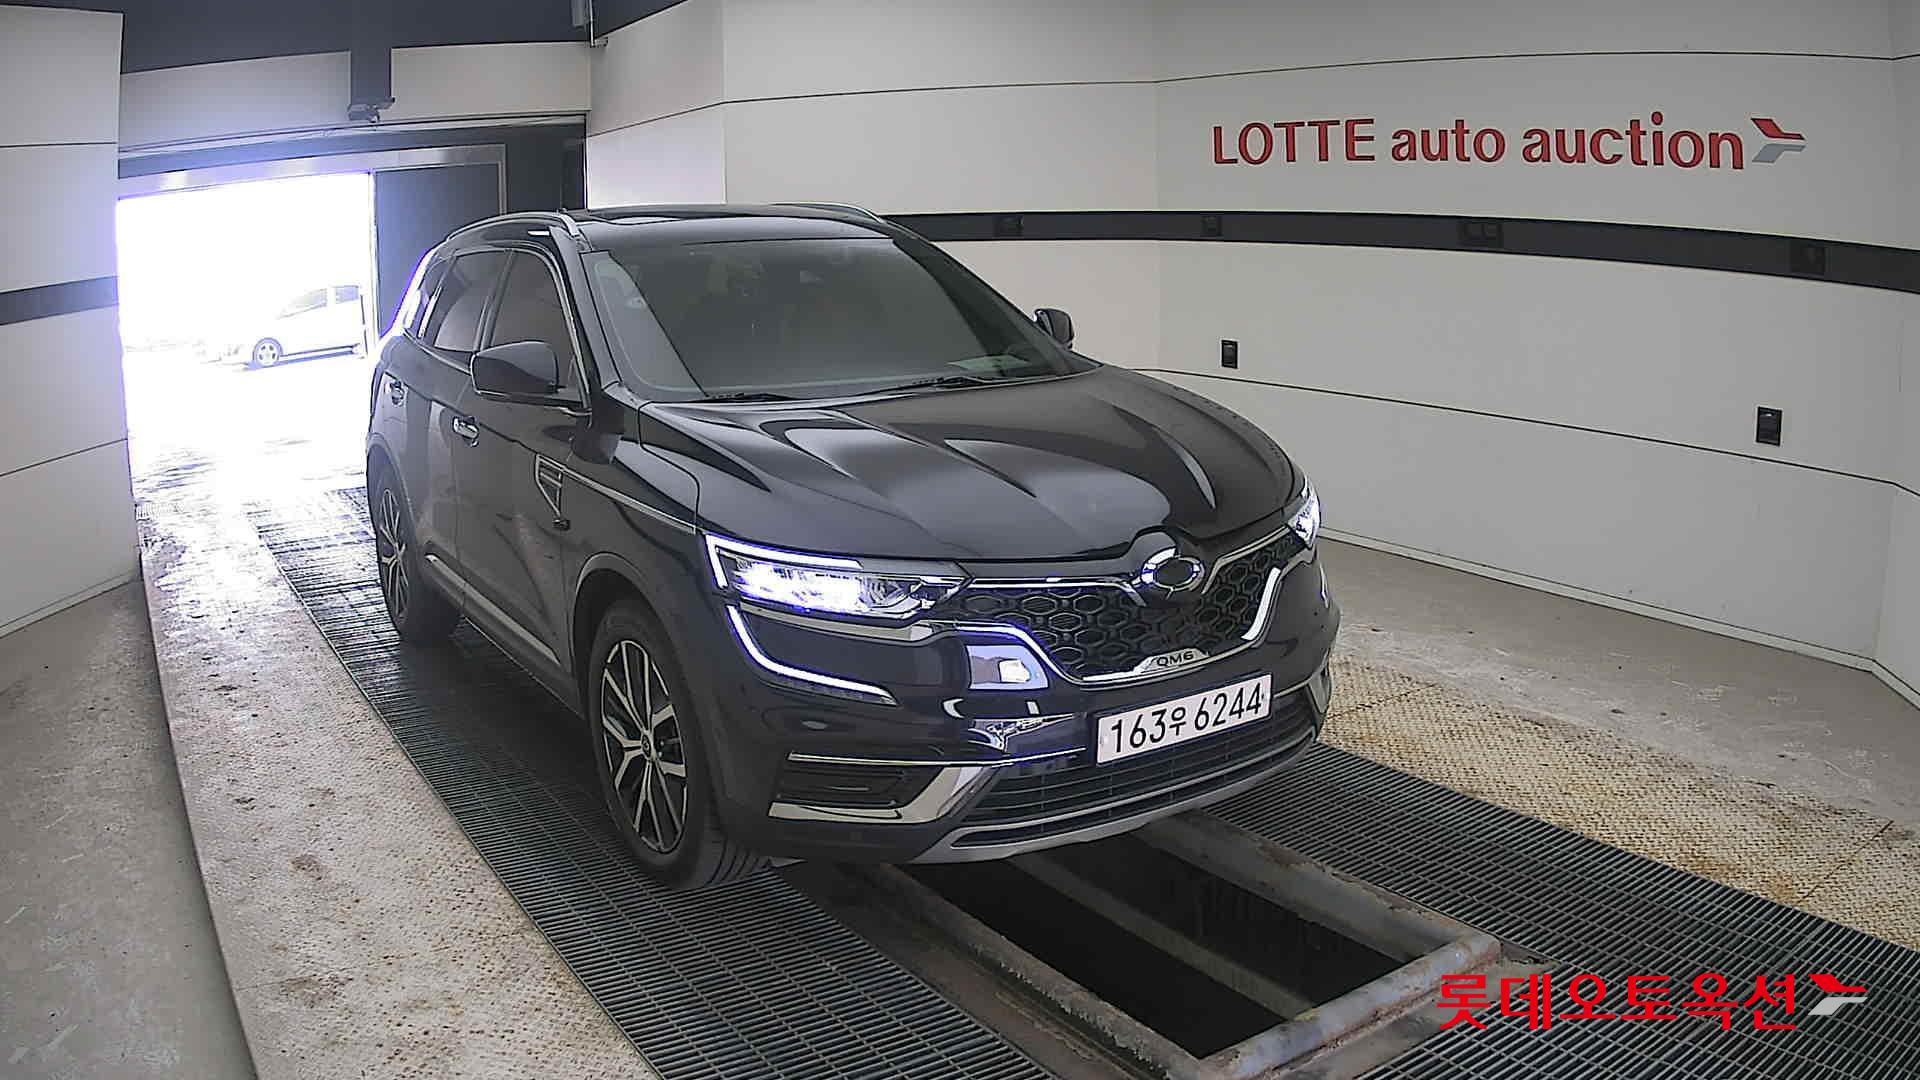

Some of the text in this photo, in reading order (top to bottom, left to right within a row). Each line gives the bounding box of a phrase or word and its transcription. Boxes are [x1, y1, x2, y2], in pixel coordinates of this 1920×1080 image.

[1213, 111, 1745, 170] LOTTE auto auction
[1156, 650, 1195, 667] QM6
[1111, 682, 1262, 753] 163우 6244
